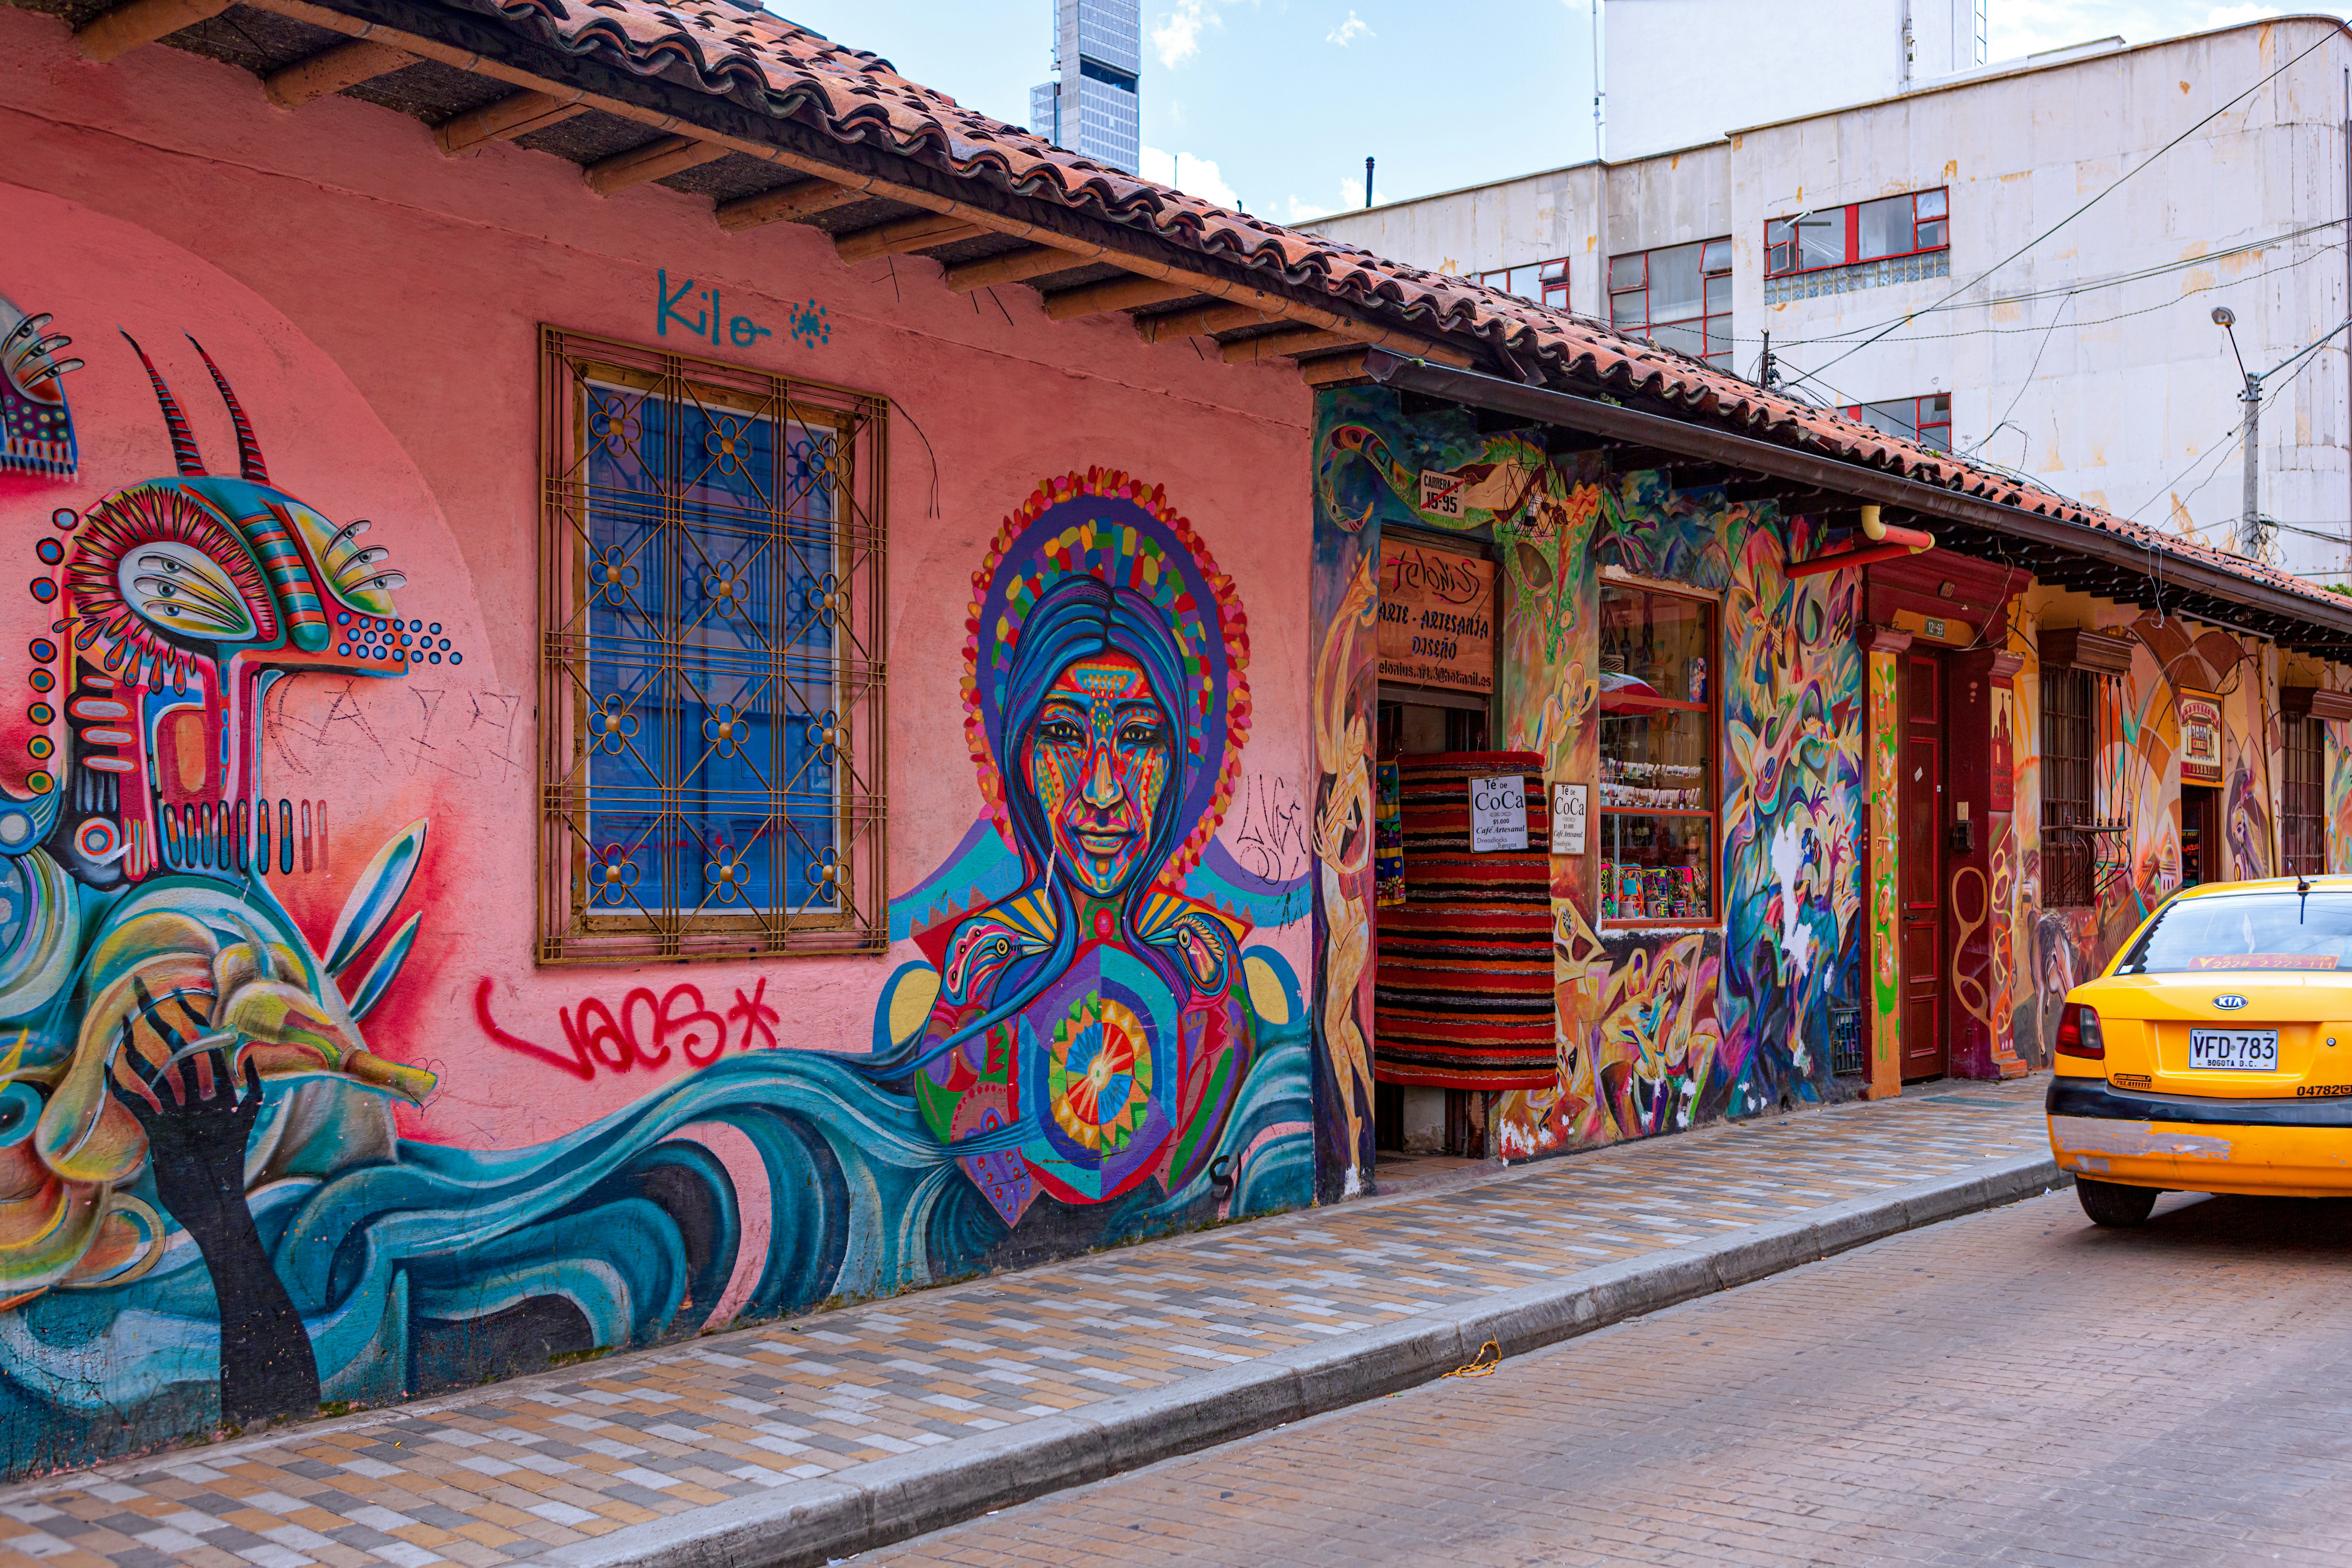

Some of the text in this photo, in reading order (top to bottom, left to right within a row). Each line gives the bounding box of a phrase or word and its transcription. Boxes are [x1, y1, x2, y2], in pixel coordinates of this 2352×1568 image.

[1427, 491, 1457, 514] 15-95
[1378, 602, 1408, 624] ARTE
[1420, 610, 1488, 640] ARTESANÍA
[1412, 636, 1457, 660] DISEÑO
[1484, 779, 1497, 790] Té
[1562, 785, 1568, 795] Té
[1475, 791, 1524, 811] CoCa
[1555, 797, 1584, 816] CoCa
[1476, 825, 1525, 835] Café Artesanal
[1554, 830, 1564, 839] Café
[2219, 997, 2242, 1006] KIA
[2193, 1036, 2275, 1059] VFD 783
[2297, 1085, 2340, 1096] 04782
